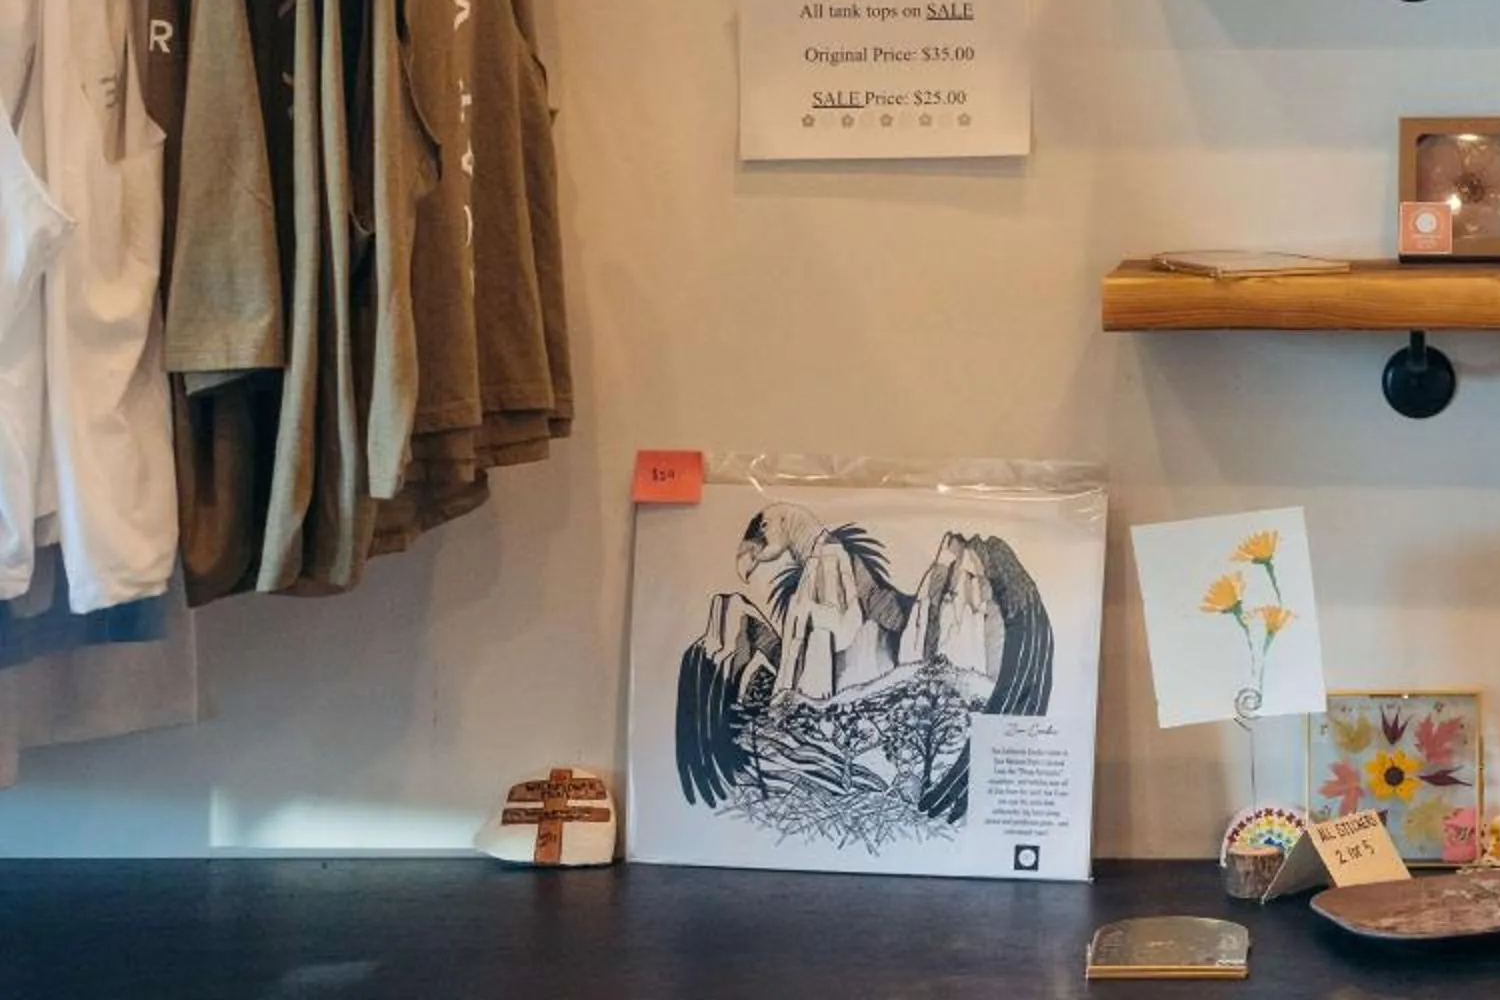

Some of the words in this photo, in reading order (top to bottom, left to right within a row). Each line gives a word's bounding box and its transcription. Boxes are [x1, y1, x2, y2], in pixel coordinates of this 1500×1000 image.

[800, 3, 823, 19] All
[829, 2, 861, 19] tank
[867, 3, 899, 24] tops
[902, 5, 921, 19] on
[926, 2, 975, 20] SALE
[804, 46, 868, 67] Original
[873, 48, 917, 63] Price:
[921, 47, 975, 63] $35.00
[812, 90, 862, 108] SALE
[865, 91, 909, 106] Price:
[913, 89, 968, 106] $25.00
[1335, 849, 1347, 864] 2
